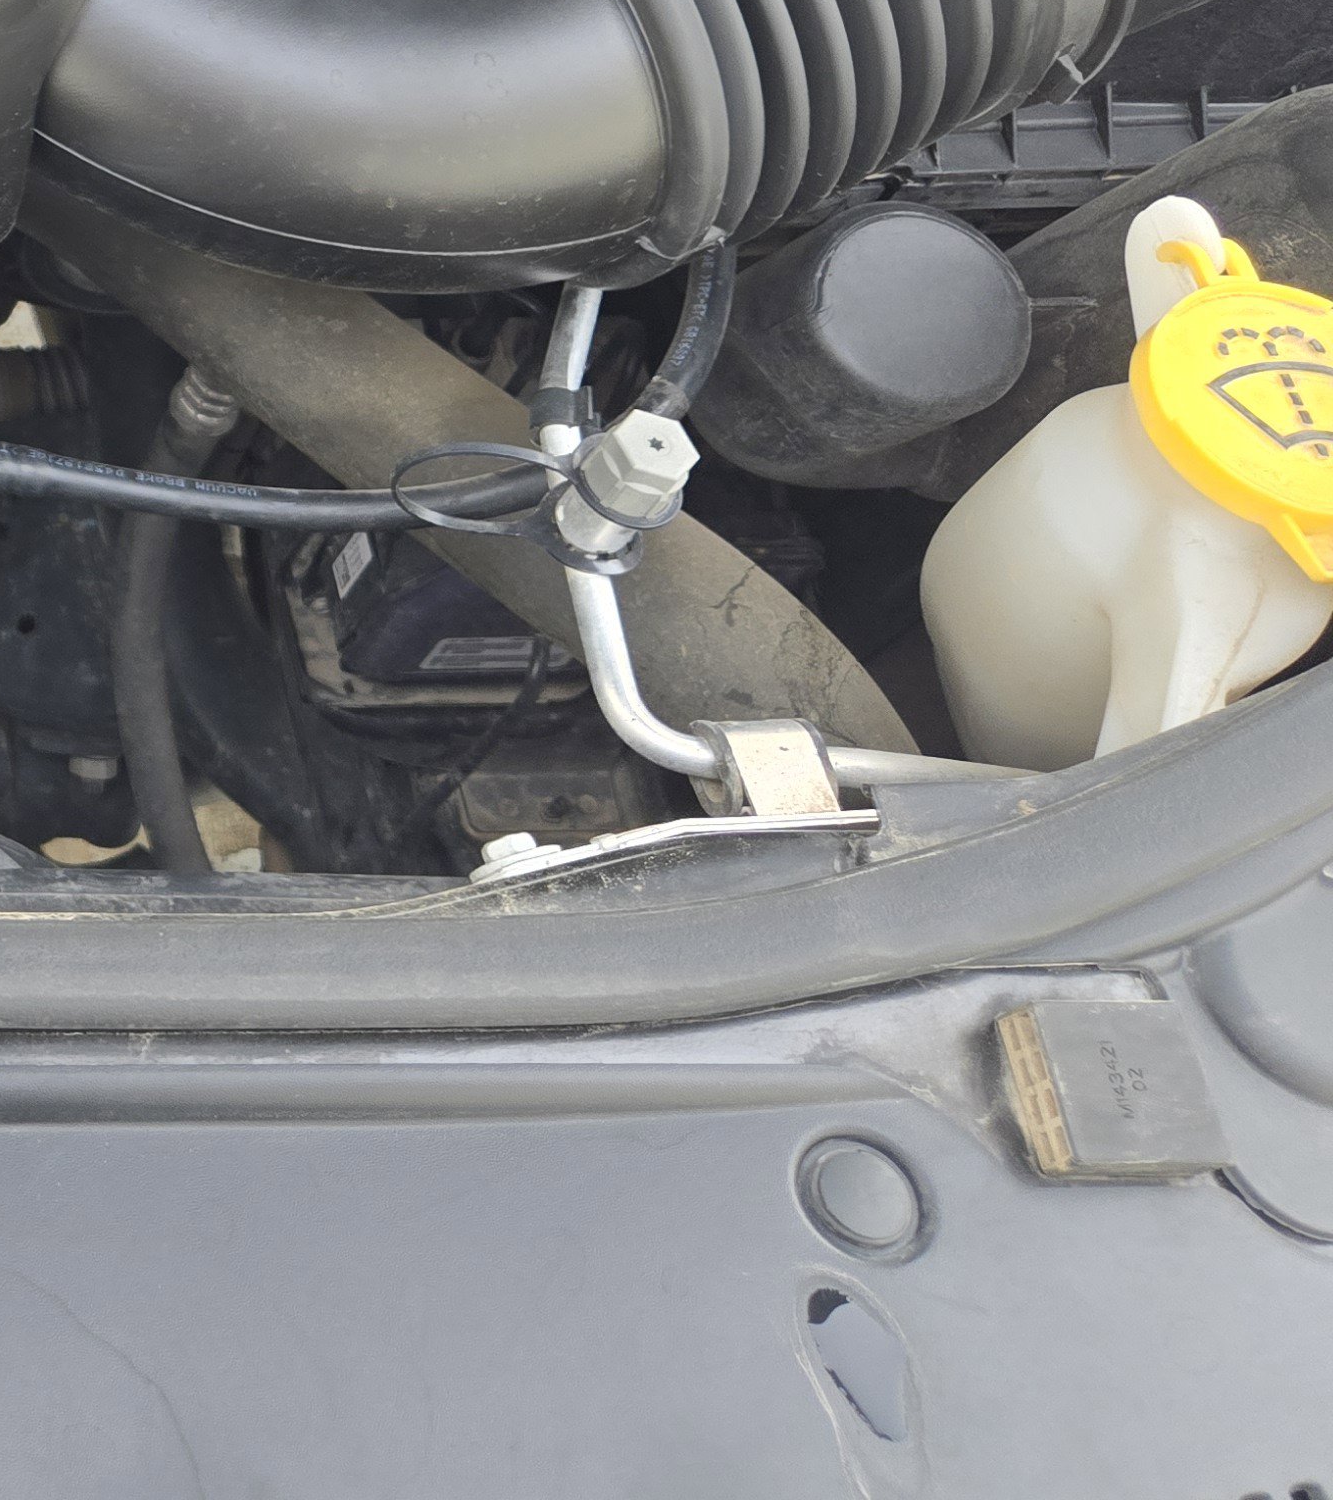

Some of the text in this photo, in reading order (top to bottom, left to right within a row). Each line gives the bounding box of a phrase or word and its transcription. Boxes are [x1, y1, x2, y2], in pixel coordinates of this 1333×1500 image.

[135, 472, 186, 488] BRAKE
[195, 481, 258, 497] VACUUM
[1127, 1067, 1148, 1092] 02
